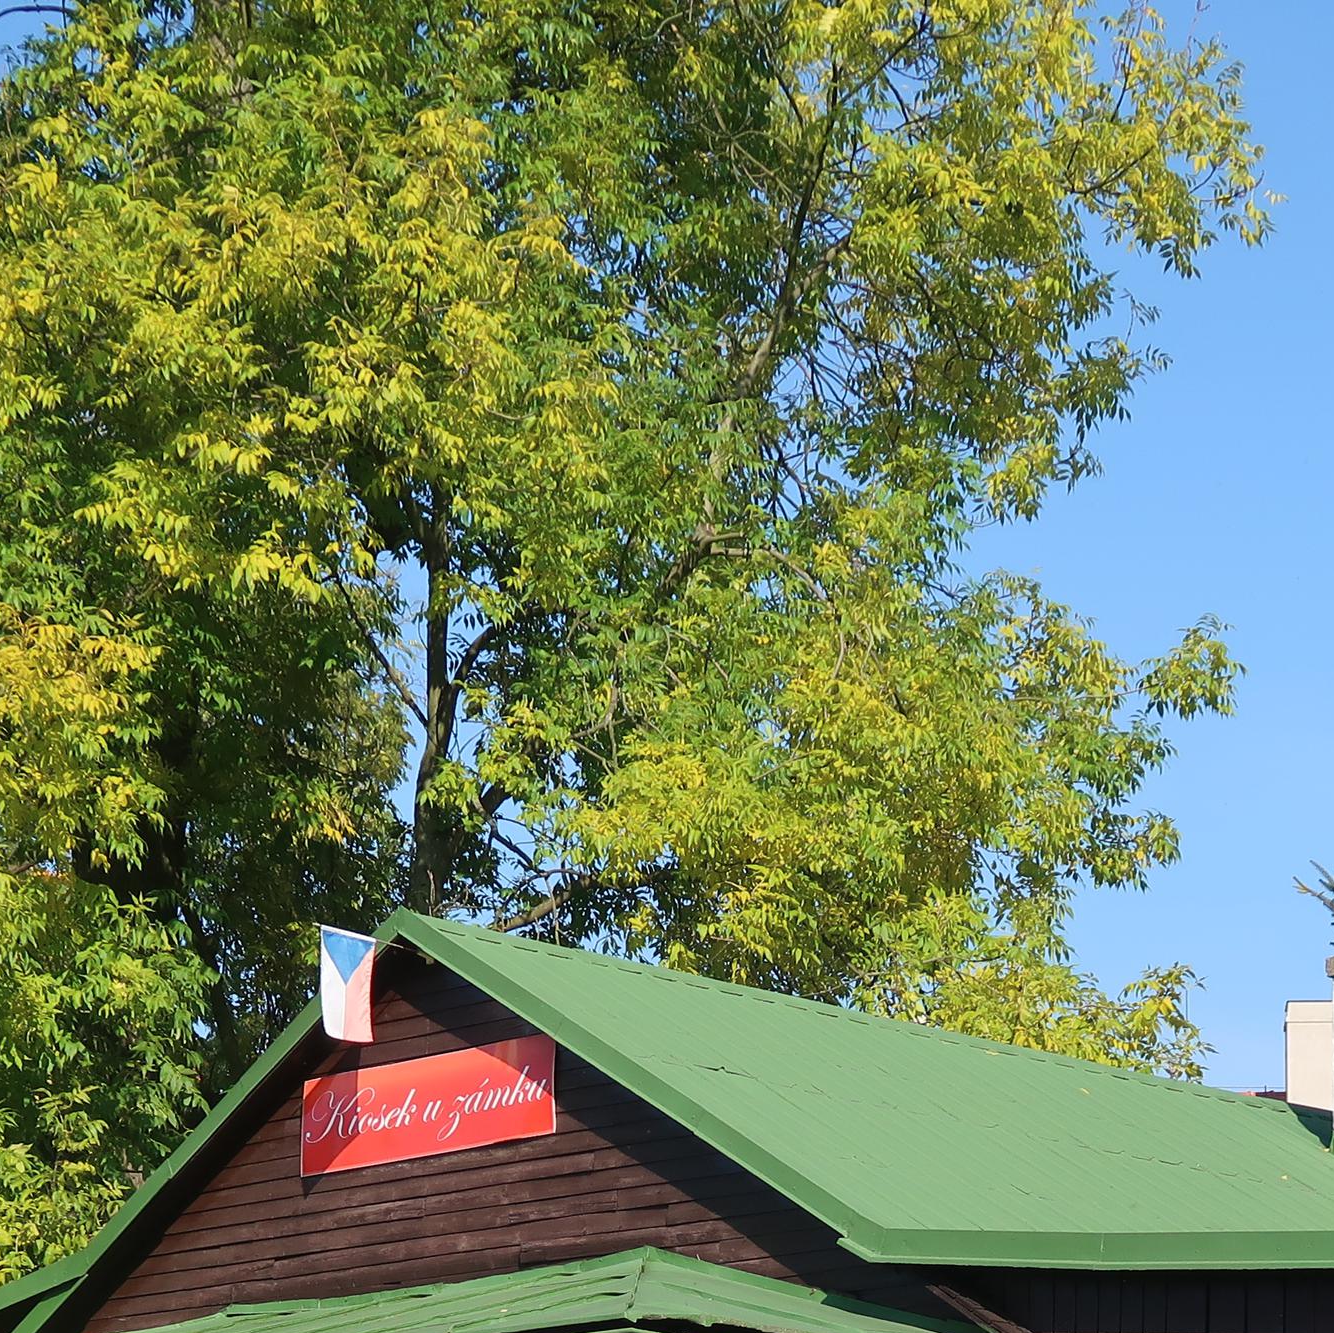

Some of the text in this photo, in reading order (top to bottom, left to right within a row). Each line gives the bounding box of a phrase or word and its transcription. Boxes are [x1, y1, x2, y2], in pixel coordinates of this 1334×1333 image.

[305, 1065, 550, 1143] Kiosek u zámku
